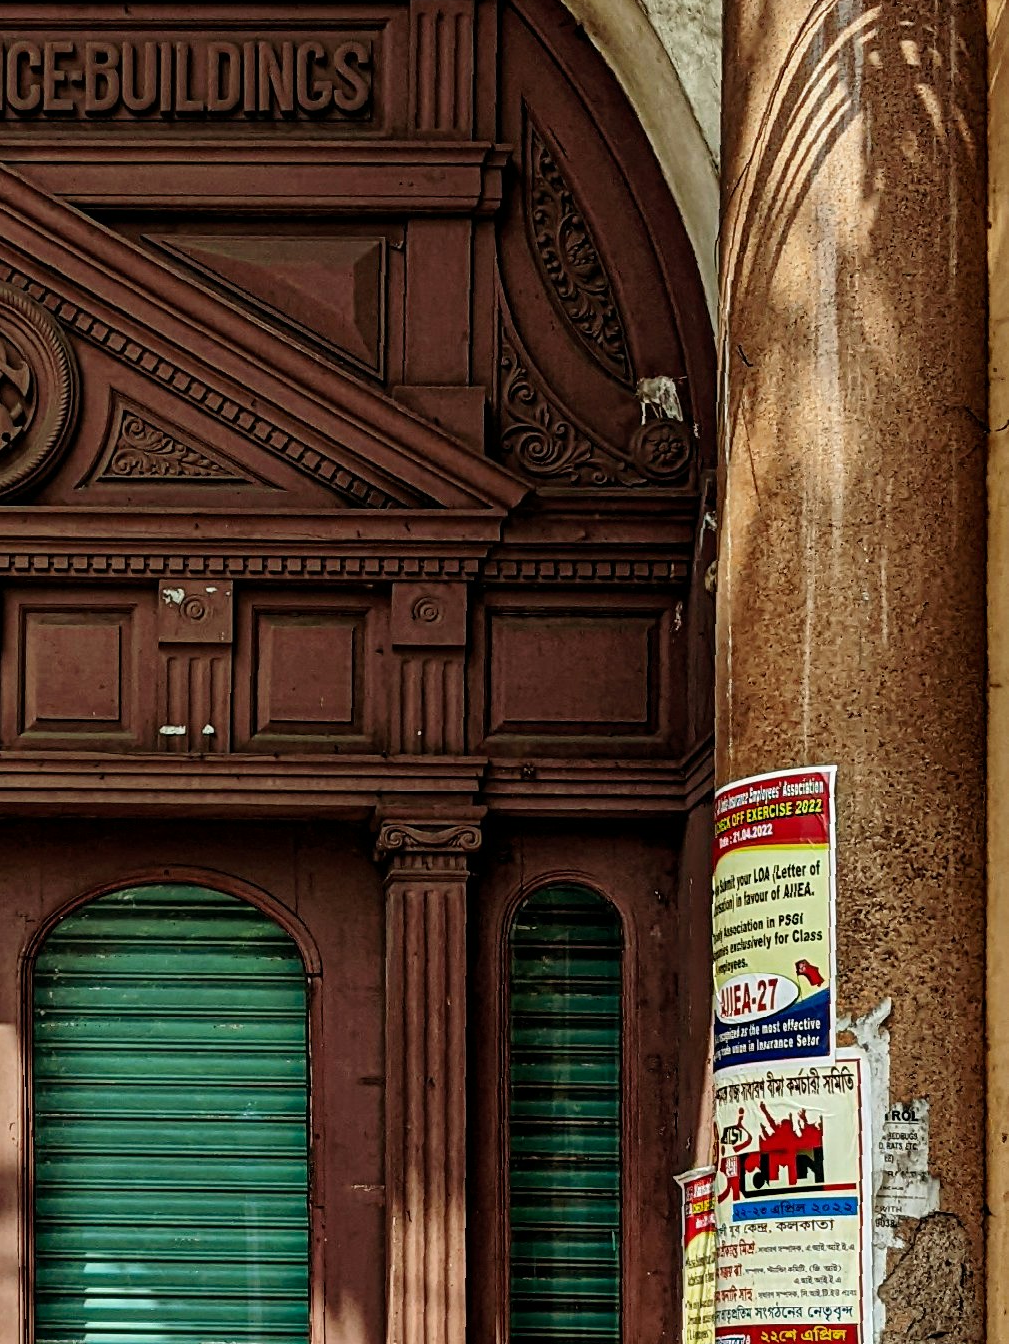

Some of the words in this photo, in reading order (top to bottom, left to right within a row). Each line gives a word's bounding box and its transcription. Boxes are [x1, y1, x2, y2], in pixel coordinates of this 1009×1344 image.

[84, 40, 370, 115] BUILDINGS
[783, 778, 824, 796] Association
[732, 811, 745, 827] OFF
[747, 802, 793, 823] EXERCISE
[795, 799, 823, 815] 2022
[733, 823, 773, 843] 21.04.2022
[737, 874, 751, 891] your
[754, 866, 770, 883] LOA
[772, 864, 806, 884] (Letter
[810, 860, 820, 875] of
[736, 893, 742, 907] in
[744, 890, 768, 905] favour
[771, 885, 780, 900] of
[724, 918, 763, 937] Association
[766, 917, 775, 928] in
[730, 934, 771, 954] exclusively
[775, 932, 789, 945] for
[792, 929, 823, 942] Class
[749, 1024, 759, 1036] the
[761, 1021, 780, 1034] most
[783, 1017, 821, 1032] effective
[757, 1037, 793, 1051] Insurance
[822, 1066, 854, 1094] সমিতি
[812, 1202, 852, 1213] ২০২২
[775, 1219, 834, 1232] কলকাতা
[755, 1302, 803, 1319] সংগঠনের
[808, 1305, 853, 1321] নেতৃবৃন্দ
[760, 1329, 797, 1343] ২২শে
[801, 1325, 847, 1342] এপ্রিল
